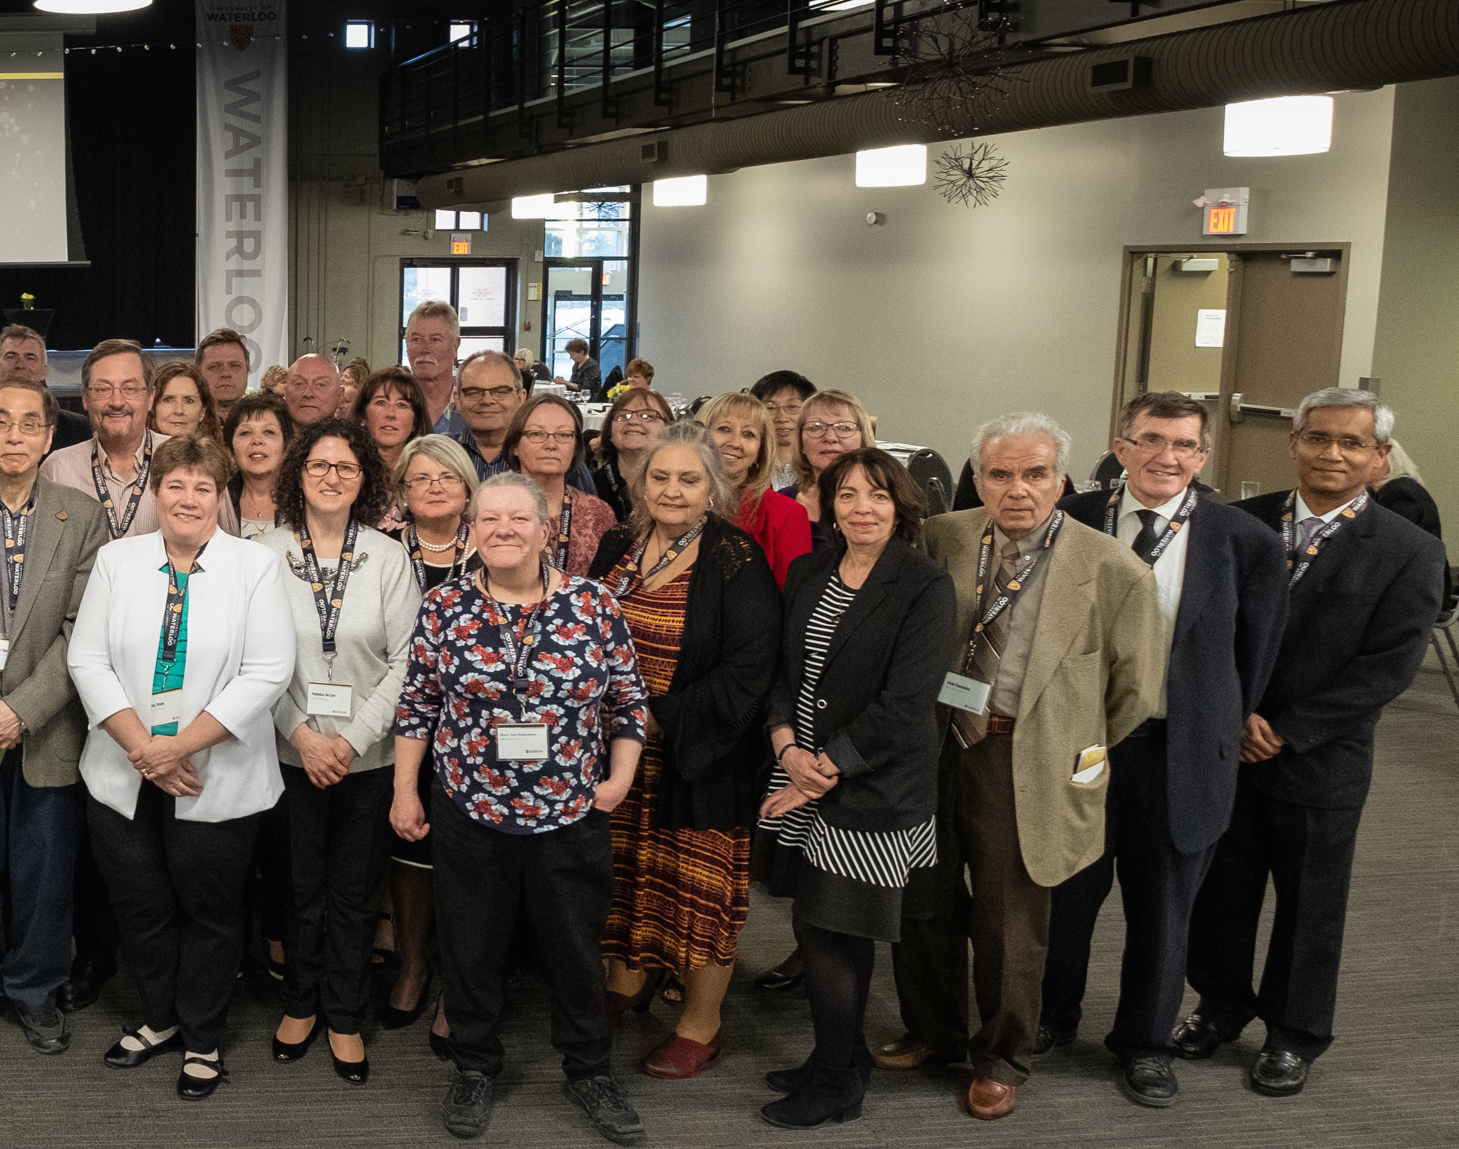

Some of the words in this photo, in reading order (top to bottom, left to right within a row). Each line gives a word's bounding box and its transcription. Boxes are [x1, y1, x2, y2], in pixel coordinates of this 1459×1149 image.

[207, 12, 276, 21] WATERLOO
[1209, 208, 1236, 233] EXIT
[453, 242, 468, 255] EXIT
[120, 501, 136, 531] WATERLOO
[1149, 528, 1174, 556] WATERLOO
[306, 552, 319, 582] WATERLOO
[335, 559, 349, 591] WATERLOO
[978, 544, 987, 576] WATERLOO
[12, 563, 20, 594] WATERLOO
[324, 607, 338, 639] WATERLOO
[982, 595, 1008, 625] WATERLOO
[167, 612, 178, 645] WATERLOO
[516, 644, 528, 676] WATERLOO
